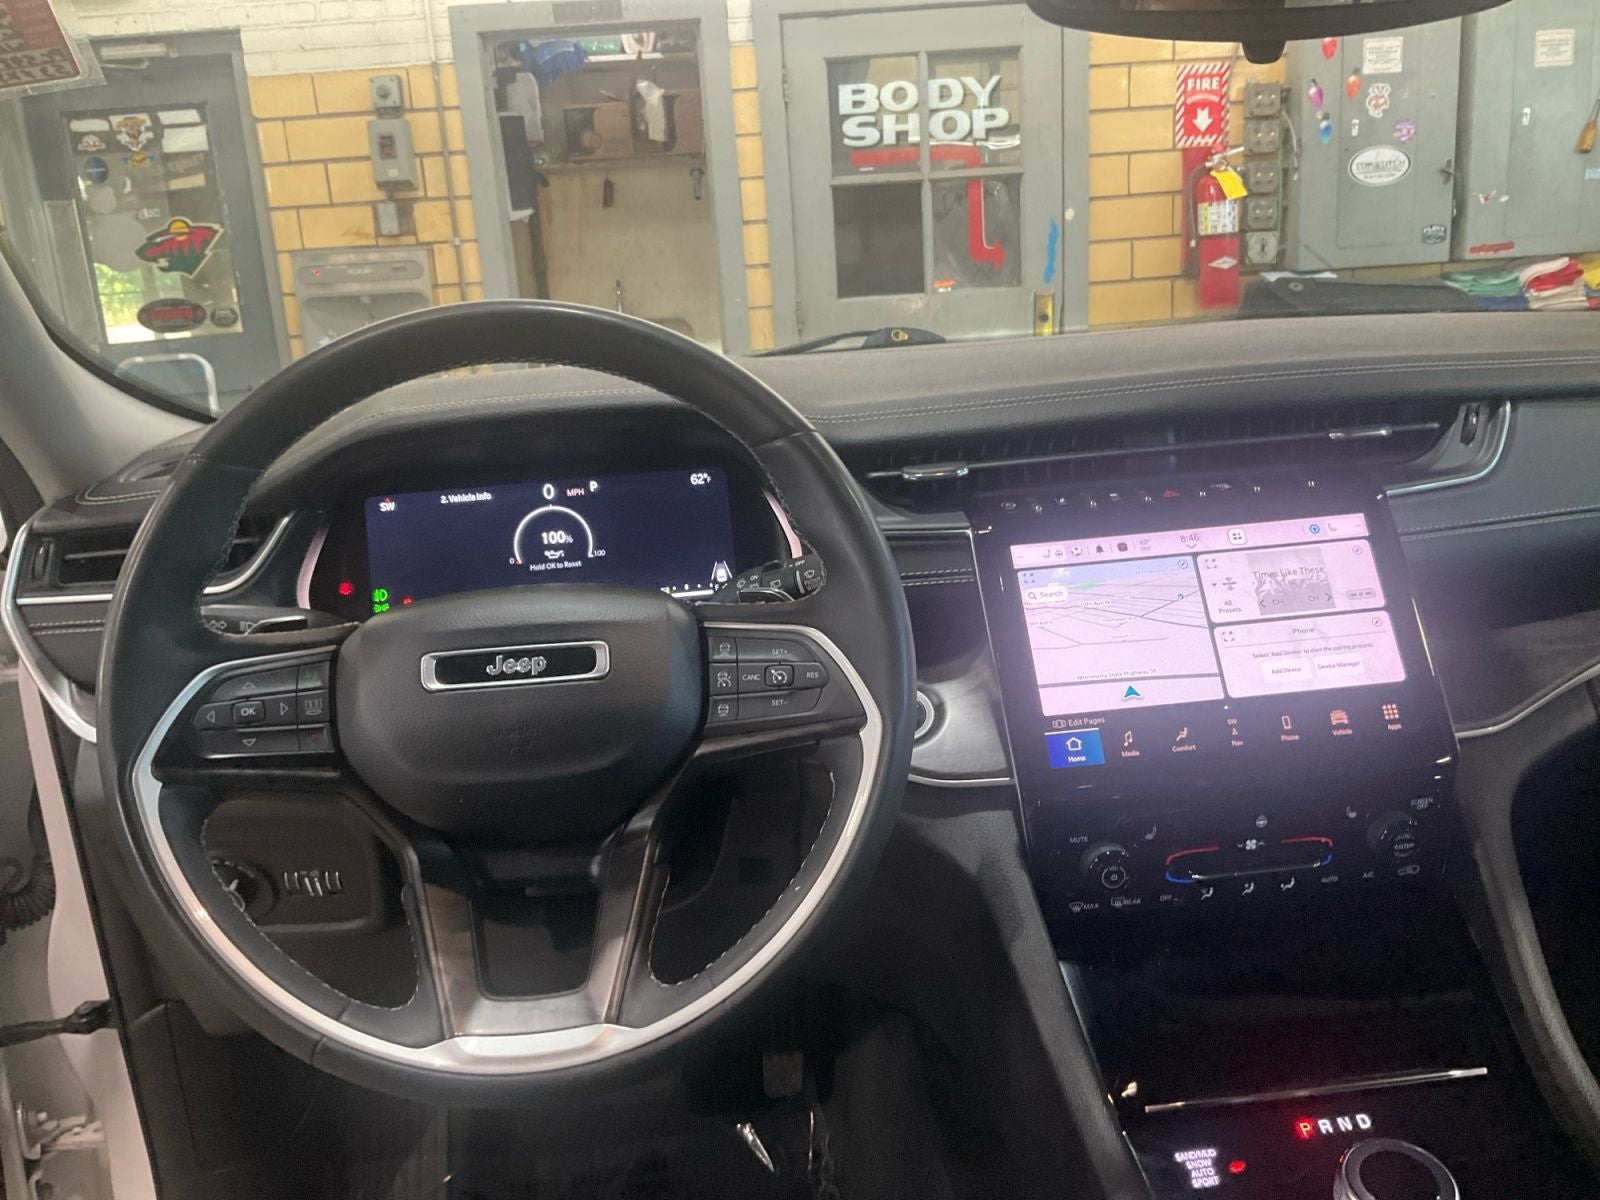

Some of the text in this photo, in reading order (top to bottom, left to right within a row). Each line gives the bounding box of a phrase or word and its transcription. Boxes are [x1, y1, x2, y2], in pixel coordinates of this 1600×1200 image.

[1187, 77, 1220, 91] FIRE
[838, 75, 1001, 115] BODY
[842, 107, 1010, 147] SHOP
[589, 480, 598, 492] P
[543, 483, 585, 500] 0 MPH
[448, 492, 476, 503] Vehicle
[476, 491, 492, 501] Info
[380, 502, 395, 512] SW
[541, 530, 574, 545] 100%
[593, 549, 606, 557] 100
[529, 564, 546, 572] Hold
[546, 562, 556, 570] OK
[563, 560, 582, 568] Reset
[1252, 571, 1278, 579] Times
[1300, 566, 1325, 574] These
[1039, 590, 1064, 599] Search
[1292, 627, 1314, 635] Phone
[486, 654, 547, 675] Jeep
[1317, 661, 1361, 671] Device Manager
[806, 671, 819, 679] RES
[1282, 666, 1302, 674] Device
[742, 672, 761, 681] CANC
[240, 706, 256, 717] OK
[1068, 717, 1105, 727] Edit Pages
[1387, 723, 1402, 731] Apps
[1280, 734, 1300, 742] Phone
[1171, 744, 1197, 753] Comfort
[1067, 755, 1086, 763] Home
[1069, 835, 1089, 844] MUTE
[1083, 902, 1099, 910] MAX
[1299, 1113, 1372, 1138] P R N D
[1185, 1158, 1213, 1170] SNOW
[1190, 1167, 1215, 1178] AUTO
[1191, 1175, 1221, 1189] SPORT
